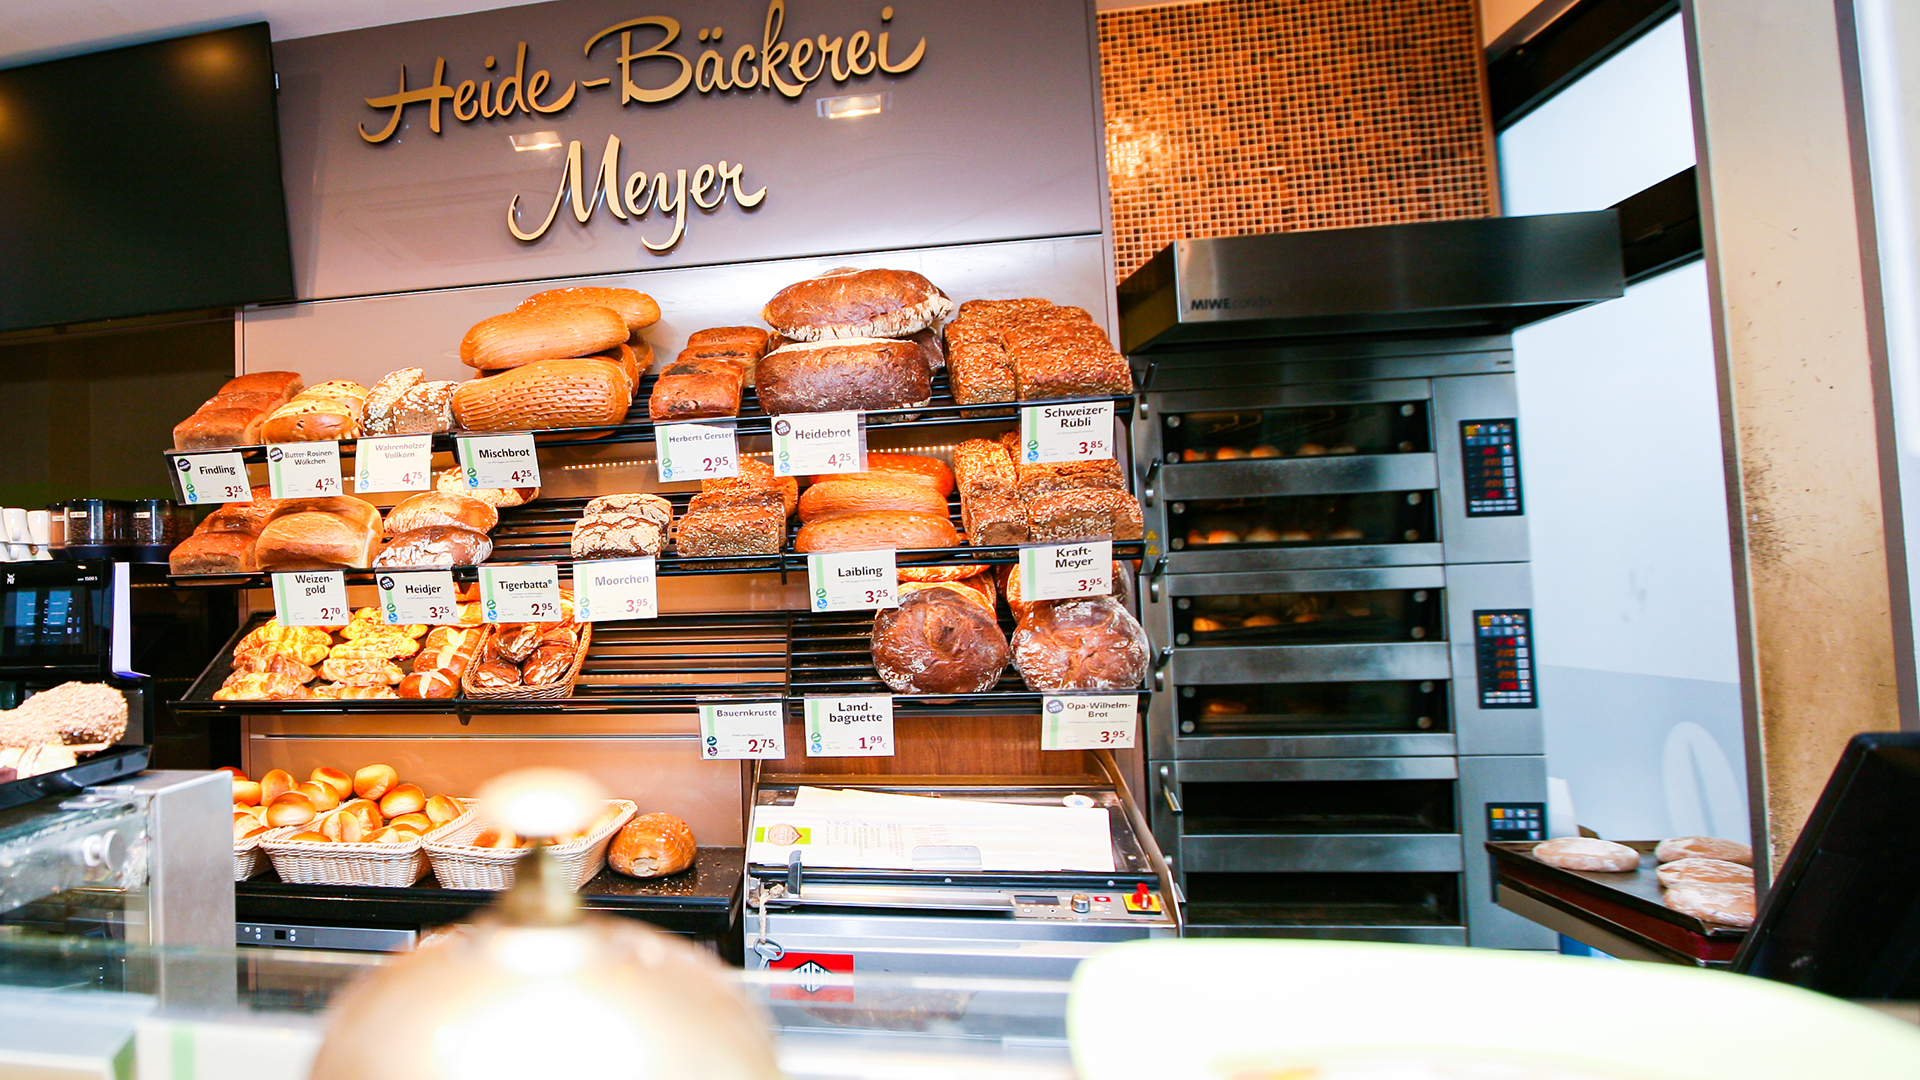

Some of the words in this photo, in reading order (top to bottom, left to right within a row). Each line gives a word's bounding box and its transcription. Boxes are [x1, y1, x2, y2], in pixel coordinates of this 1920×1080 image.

[358, 0, 926, 143] Heide-Bäckerei
[507, 134, 767, 251] Meyer
[1191, 298, 1230, 310] MIWE
[1044, 406, 1108, 418] Schweizer-
[1060, 417, 1092, 428] Rübli
[669, 434, 702, 443] Herberts
[704, 431, 733, 440] Gerster
[795, 428, 852, 440] Heidebrot
[375, 443, 426, 452] Wahrenholzer
[478, 448, 530, 459] Mischbrot
[1078, 441, 1103, 455] 3,85
[294, 458, 326, 466] Wölkchen
[703, 456, 729, 473] 2,95
[828, 453, 851, 468] 4,25
[199, 465, 236, 476] Findling
[511, 470, 532, 483] 4,25
[402, 472, 422, 485] 4,75
[315, 478, 335, 492] 4,25
[224, 486, 243, 498] 3,25
[1056, 546, 1092, 558] Kraft-
[1055, 557, 1094, 569] Meyer
[838, 566, 883, 578] Laibling
[294, 574, 333, 584] Weizen-
[595, 575, 649, 586] Moorchen
[1078, 577, 1102, 592] 3,95
[305, 584, 326, 596] gold
[405, 584, 442, 596] Heidjer
[865, 589, 889, 604] 3,25
[531, 603, 553, 617] 2,95
[626, 598, 648, 613] 3,95
[320, 607, 341, 621] 2,70
[429, 606, 450, 620] 3,25
[838, 702, 873, 712] Land-
[1066, 702, 1131, 711] Opa-Wilhelm-
[716, 709, 778, 718] Bauernkruste
[829, 713, 883, 725] baguette
[858, 736, 883, 751] 1,99
[1100, 731, 1125, 744] 3,95
[748, 739, 775, 754] 2,75
